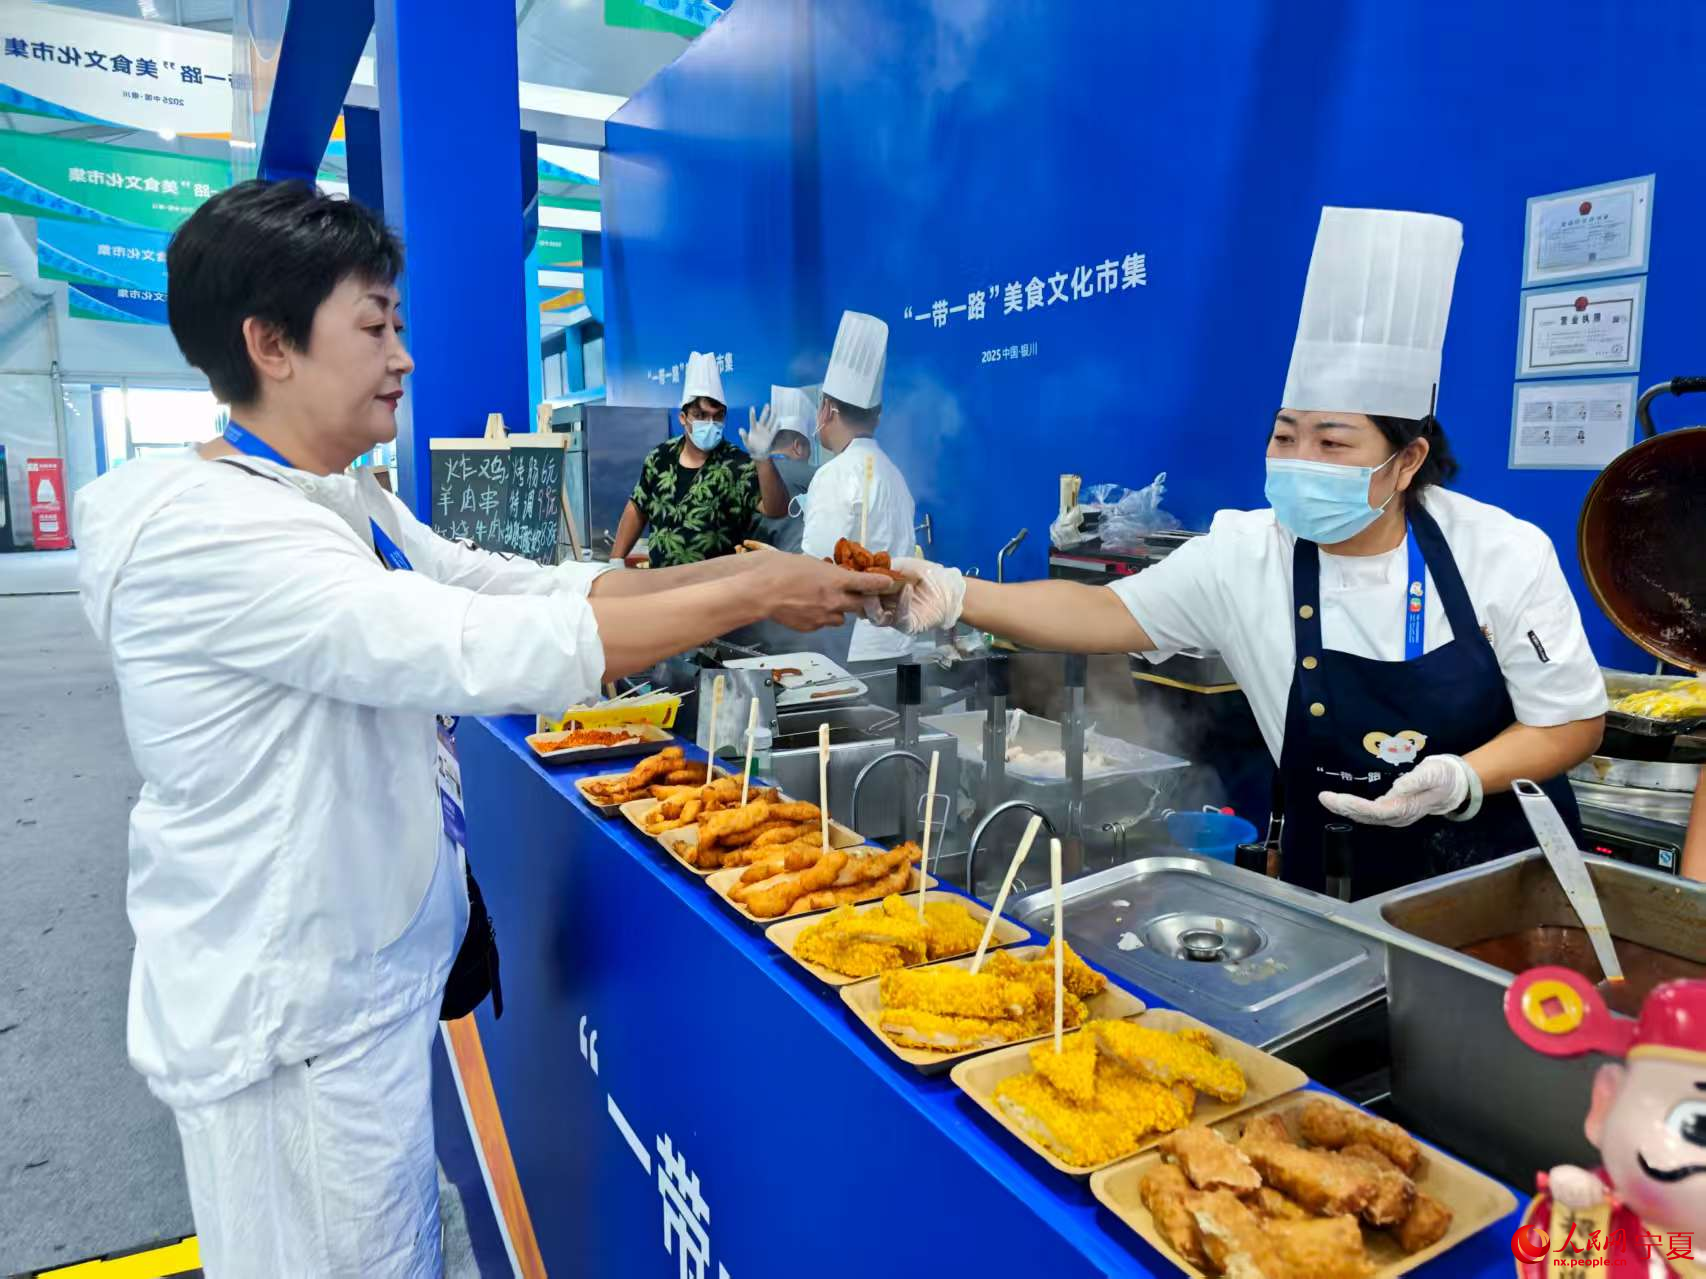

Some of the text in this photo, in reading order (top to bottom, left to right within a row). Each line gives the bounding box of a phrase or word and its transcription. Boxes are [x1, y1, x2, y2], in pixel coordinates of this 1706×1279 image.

[903, 252, 1147, 328] “一带一路”美食文化市集
[981, 348, 1001, 363] 2025
[444, 453, 509, 484] 炸鸡
[437, 484, 500, 516] 羊肉串
